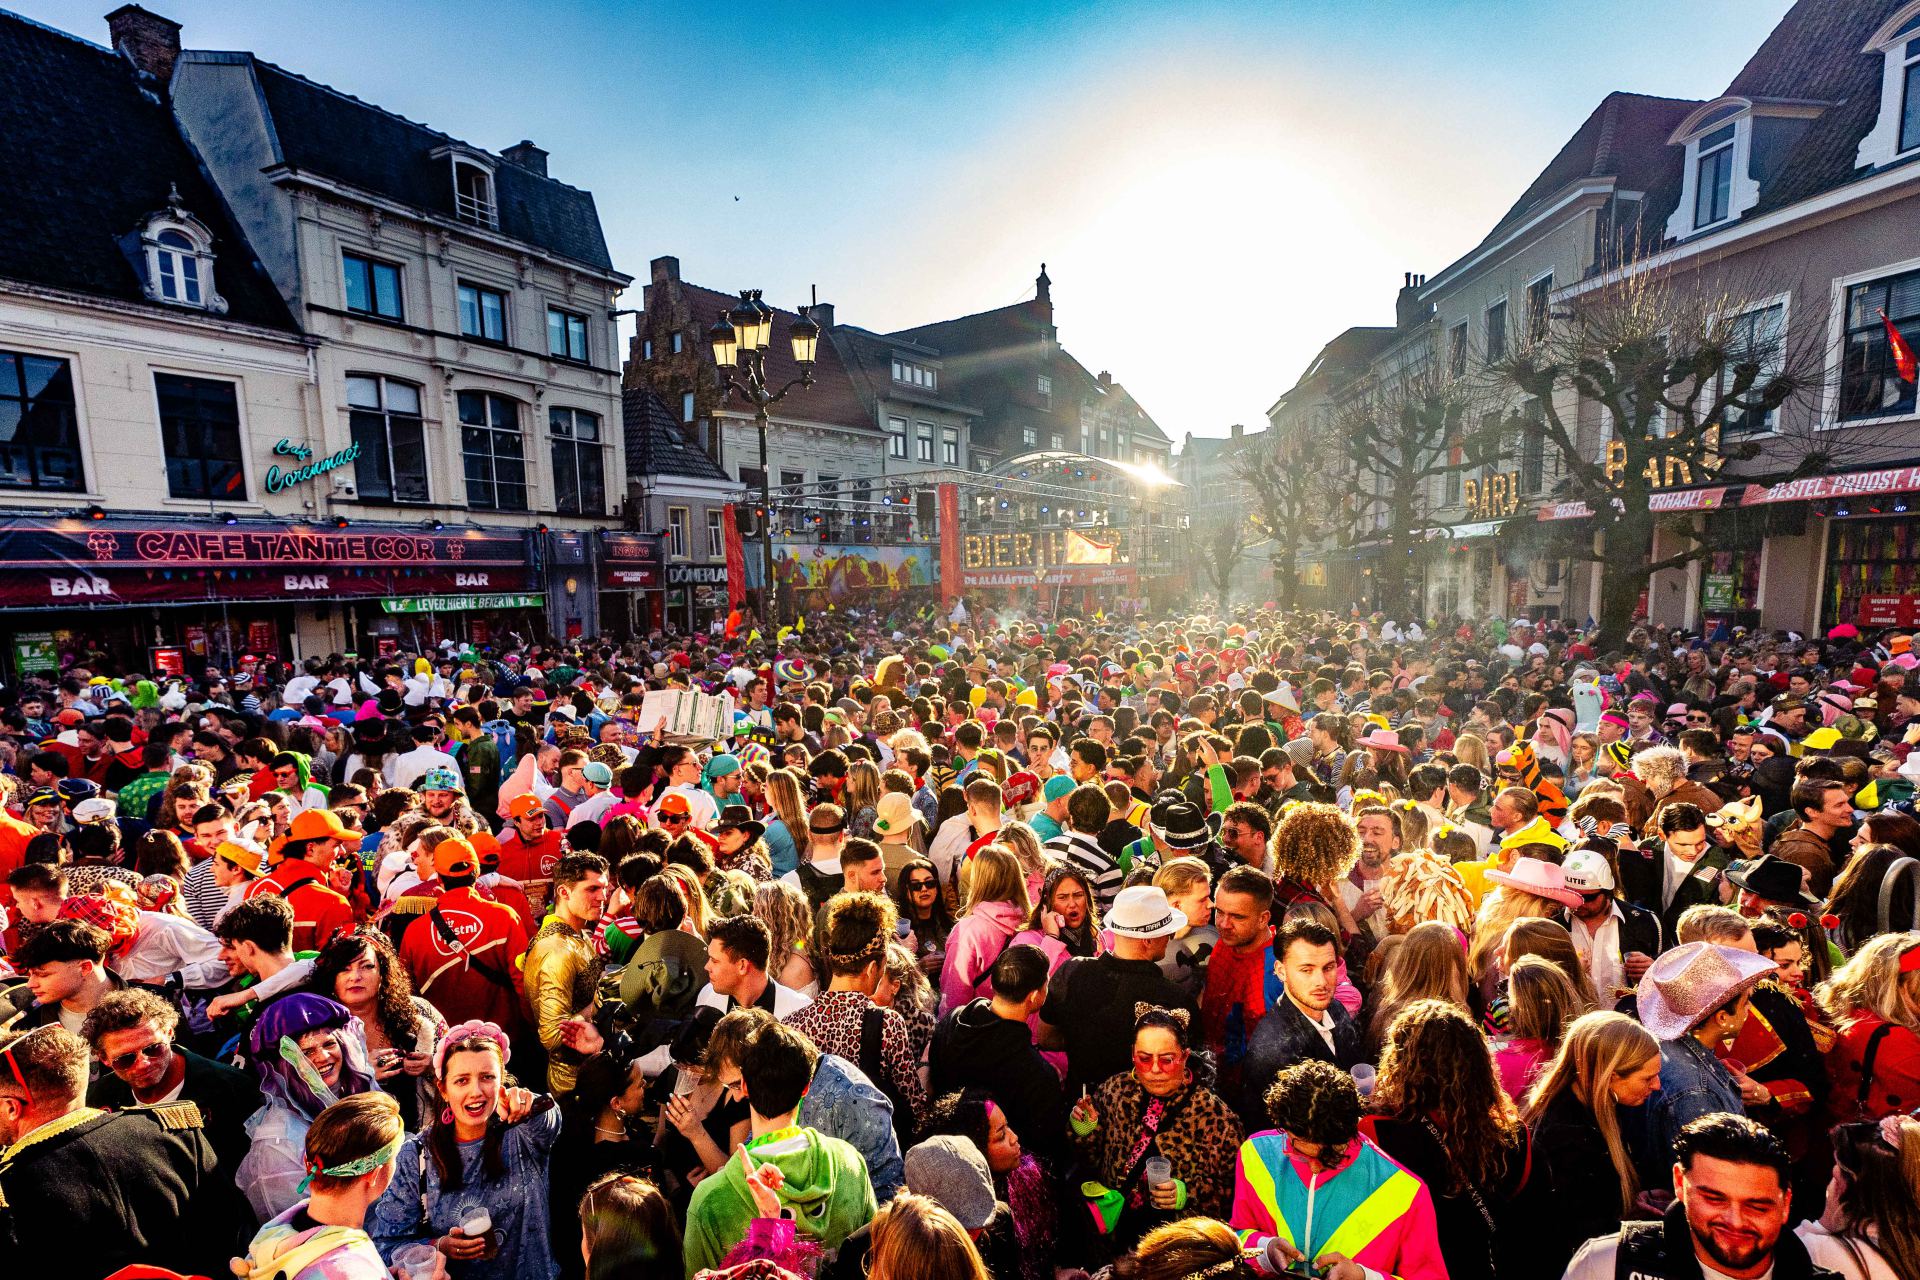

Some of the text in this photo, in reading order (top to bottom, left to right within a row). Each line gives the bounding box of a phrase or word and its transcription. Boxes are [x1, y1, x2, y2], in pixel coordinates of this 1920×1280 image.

[1766, 476, 1826, 500] BESTEL.
[1831, 469, 1904, 495] PROOST.
[137, 532, 436, 560] CAFE TANTE COR
[963, 532, 1033, 568] BIER
[50, 577, 112, 596] BAR
[284, 574, 331, 591] BAR
[455, 572, 489, 586] BAR
[416, 599, 445, 612] LEVER
[447, 598, 467, 610] HIER
[1565, 876, 1586, 886] LITIE
